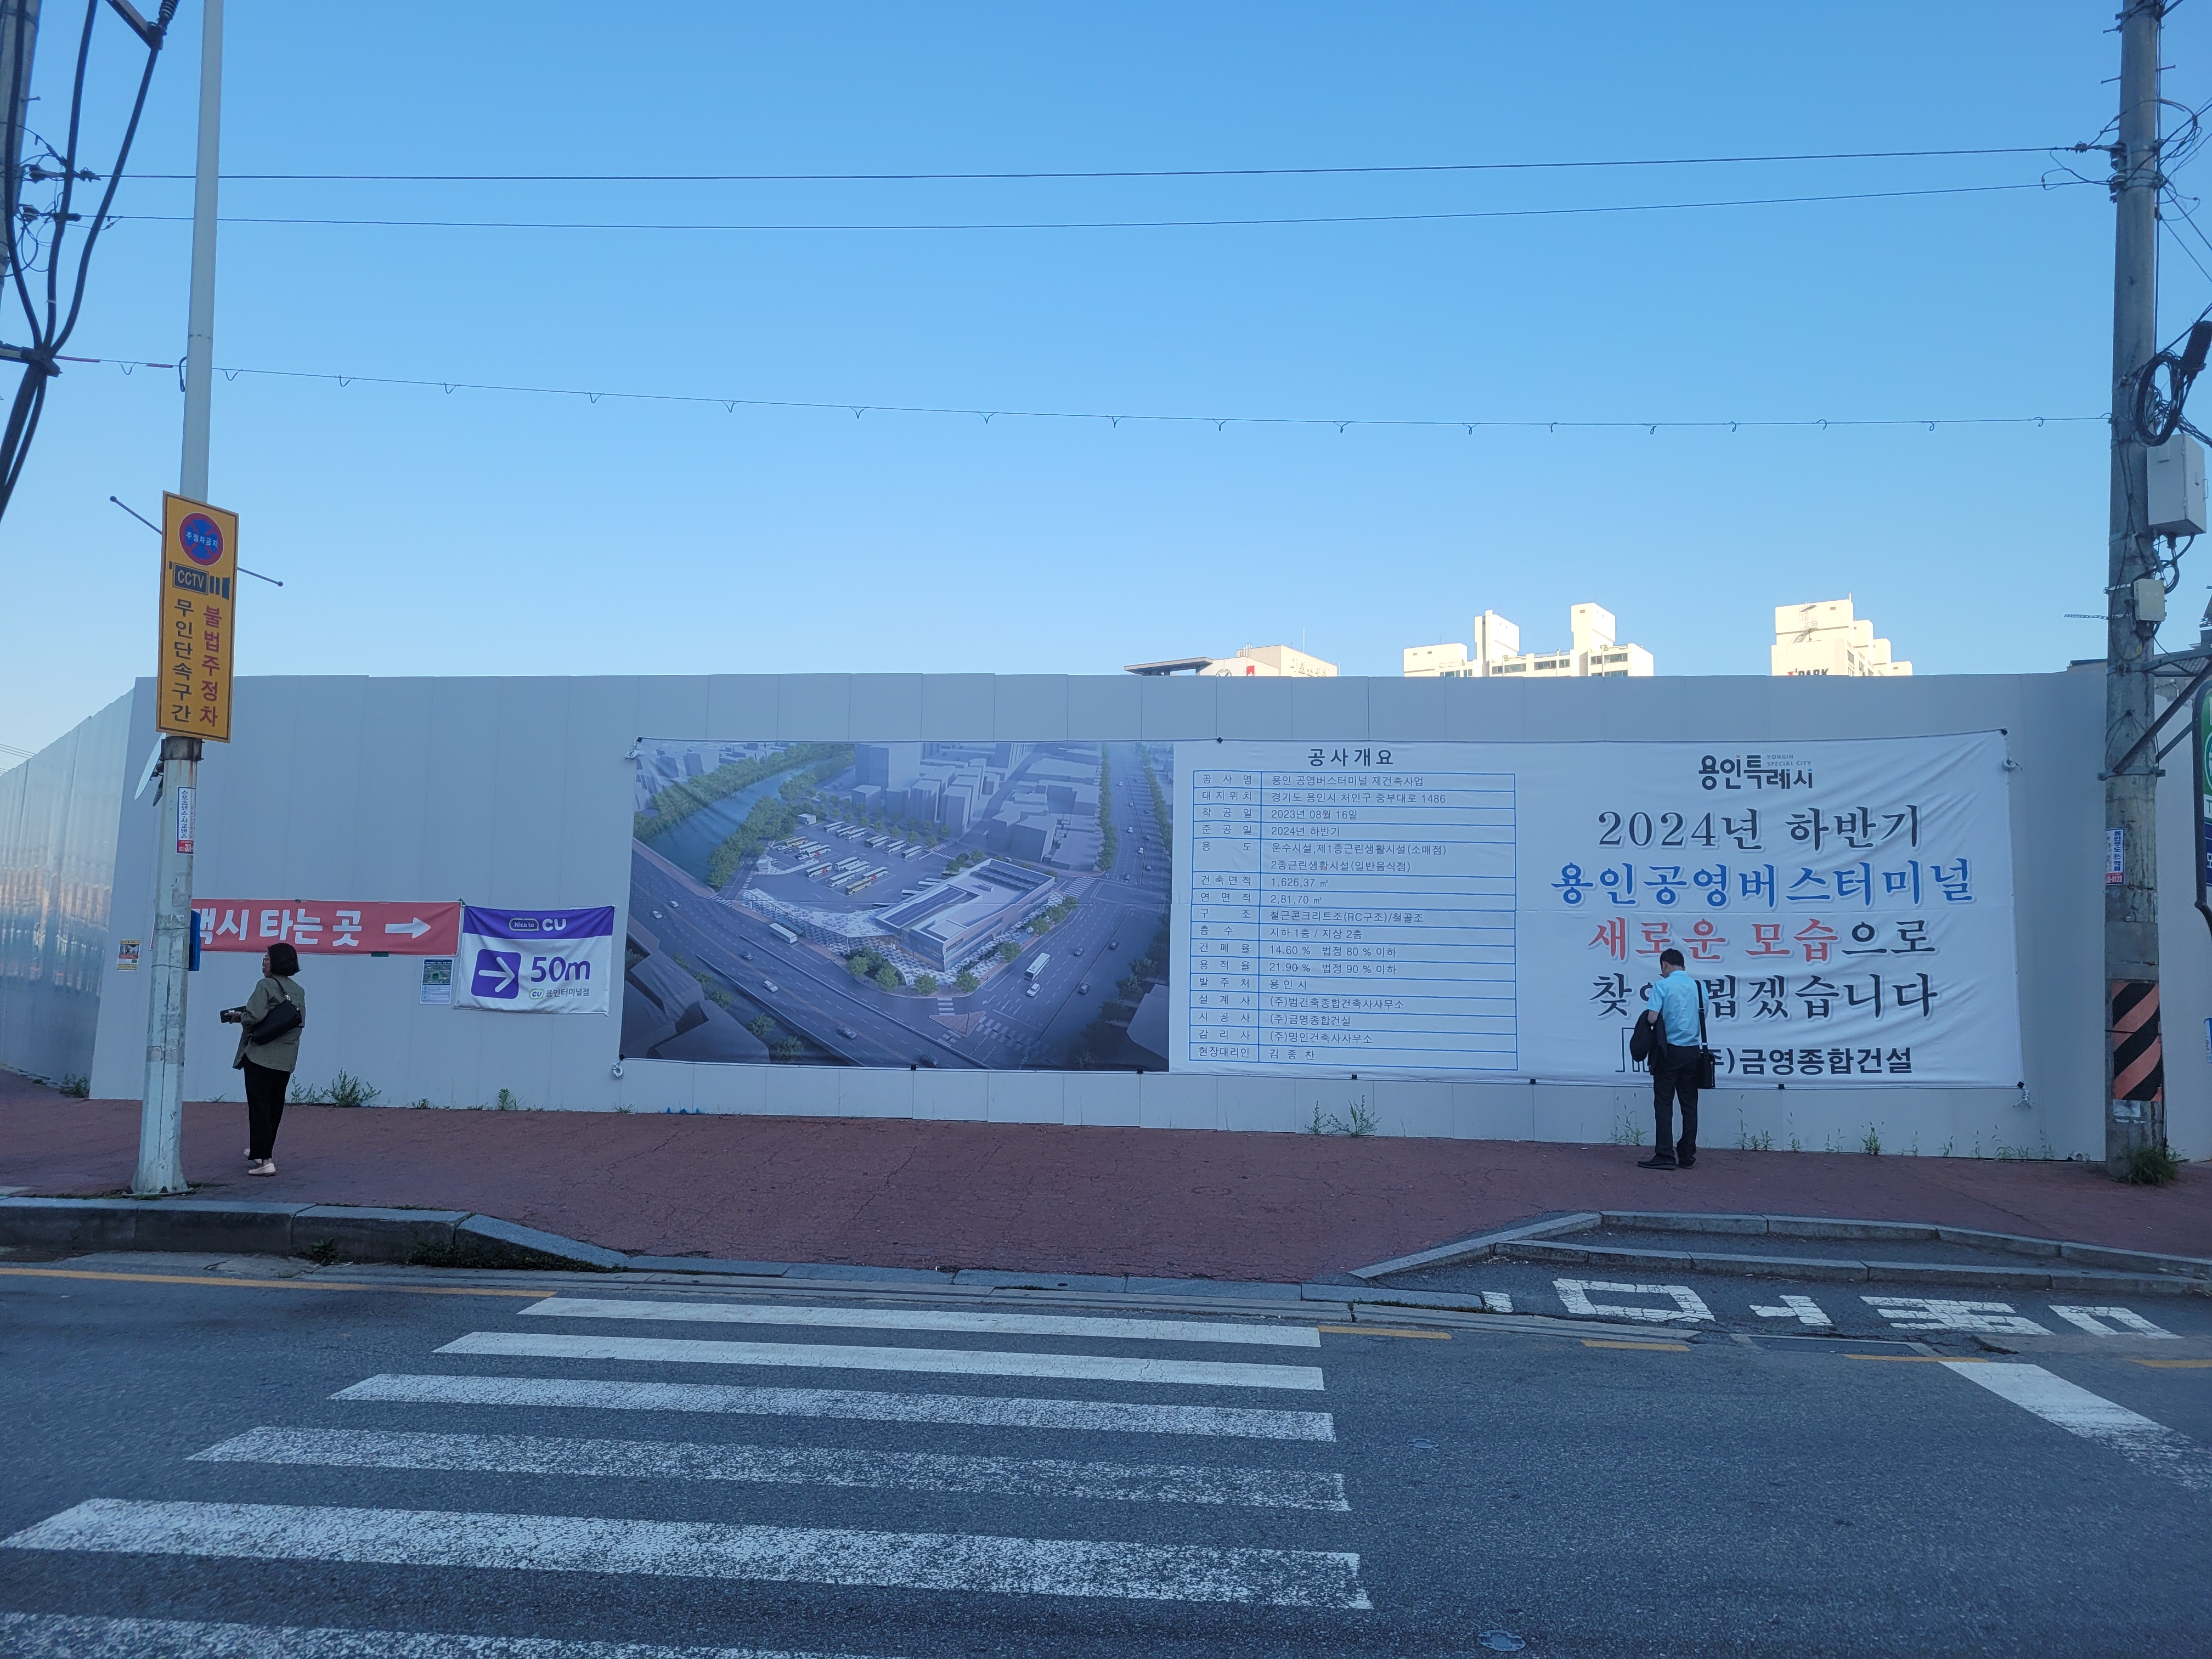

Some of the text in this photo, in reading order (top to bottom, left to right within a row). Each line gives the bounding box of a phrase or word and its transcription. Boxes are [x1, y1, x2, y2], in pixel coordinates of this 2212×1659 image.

[185, 531, 218, 548] 주정차금지
[177, 569, 204, 589] CCTV
[171, 599, 194, 723] 무인단속구간
[199, 605, 222, 727] 불법주정차
[1307, 748, 1394, 767] 공사개요
[1698, 754, 1814, 791] 용인특례시
[1272, 775, 1423, 787] 용인 공영버스터미널 재건축사업
[1271, 792, 1446, 804] 경기도 용인시 처인구 중부대로 1486
[1271, 809, 1357, 820] 2023년 08월 16일
[1271, 826, 1339, 837] 2024년 하반기
[1598, 804, 1918, 851] 2024년 하반기
[1551, 858, 1974, 907] 용인공영버스터미널
[259, 908, 324, 945] 타는
[332, 910, 363, 947] 곳
[542, 918, 566, 931] CU
[1269, 927, 1291, 938] 지하
[1294, 928, 1310, 939] 1층
[1322, 928, 1343, 939] 지상
[1346, 929, 1363, 940] 2층
[1588, 917, 1937, 963] 새로운 모습으로
[1270, 945, 1298, 955] 14.60
[1322, 945, 1341, 957] 법정
[1346, 947, 1359, 956] 80
[1376, 946, 1397, 958] 이하
[531, 956, 590, 982] 50m
[1269, 962, 1299, 972] 21.90
[1322, 963, 1341, 974] 법정
[1346, 964, 1358, 974] 90
[1376, 964, 1397, 975] 이하
[546, 988, 589, 997] 용인터미널점
[1269, 996, 1404, 1010] (주)범건축종합건축사사무소
[1270, 1013, 1351, 1026] (주)금영종합건설
[1269, 1031, 1373, 1044] (주)명인건축사사무소
[1198, 1046, 1250, 1058] 현장대리인
